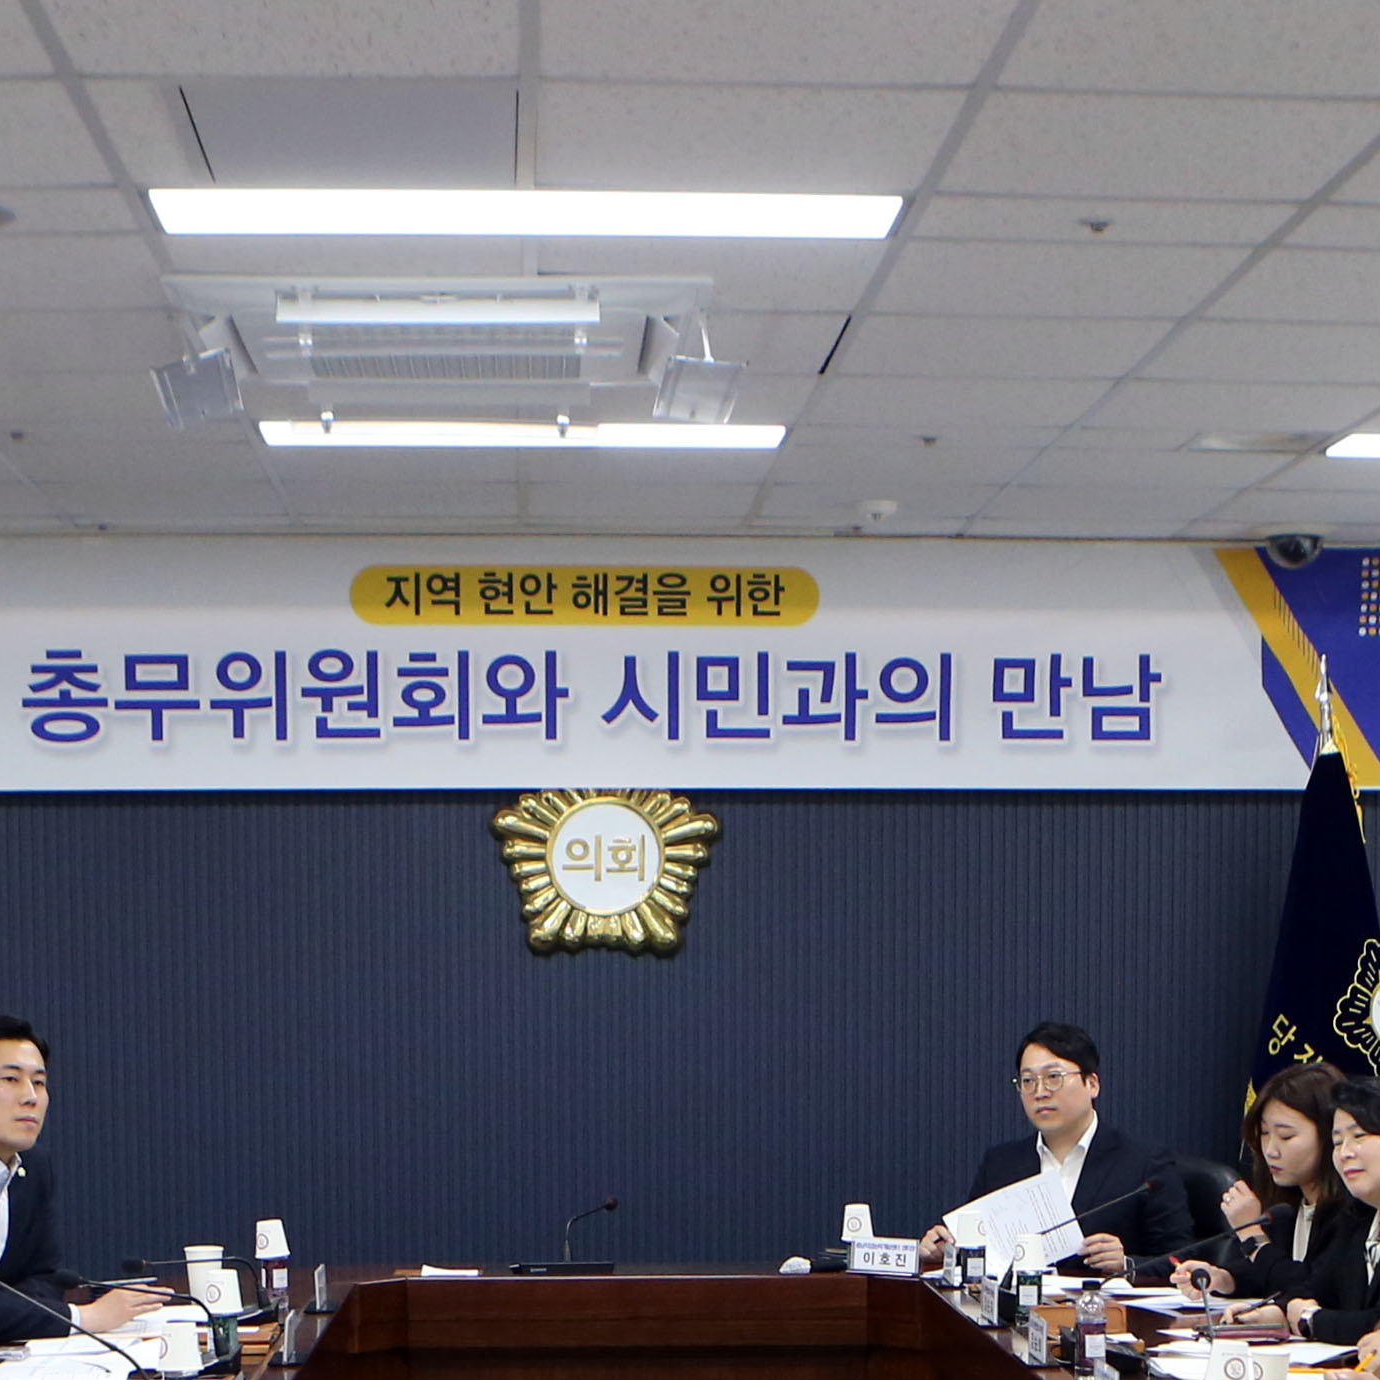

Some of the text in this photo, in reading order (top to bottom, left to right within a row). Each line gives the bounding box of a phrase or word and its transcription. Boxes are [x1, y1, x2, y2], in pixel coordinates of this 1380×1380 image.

[385, 572, 786, 617] 지역 현안 해결을 위한
[21, 649, 1163, 743] 총무위원회와 시민과의 만남
[562, 834, 646, 882] 의회
[863, 1251, 907, 1267] 이호진
